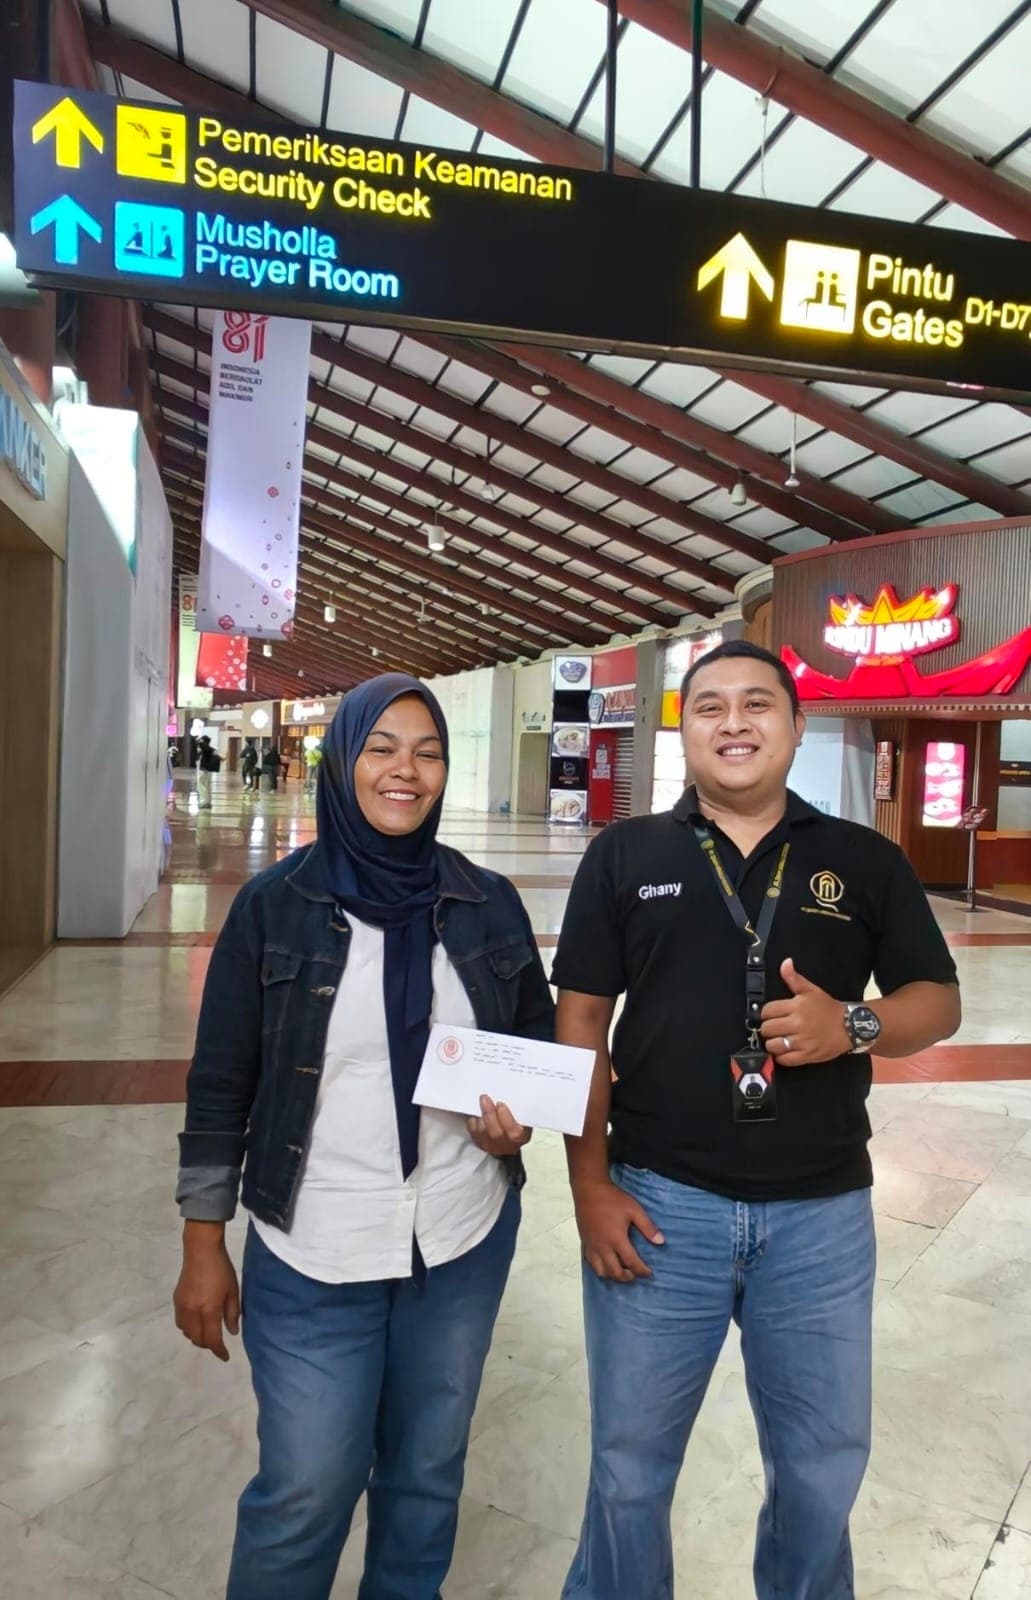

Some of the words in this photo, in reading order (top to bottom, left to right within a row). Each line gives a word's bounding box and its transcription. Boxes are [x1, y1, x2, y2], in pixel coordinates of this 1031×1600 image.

[198, 117, 404, 177] Pemeriksaan
[414, 150, 572, 201] Keamanan
[193, 156, 325, 210] Security
[332, 176, 432, 219] Check
[196, 211, 338, 261] Musholla
[195, 243, 302, 288] Prayer
[308, 257, 399, 298] Room
[866, 253, 954, 302] Pintu
[861, 300, 964, 348] Gates
[638, 882, 682, 900] Ghany
